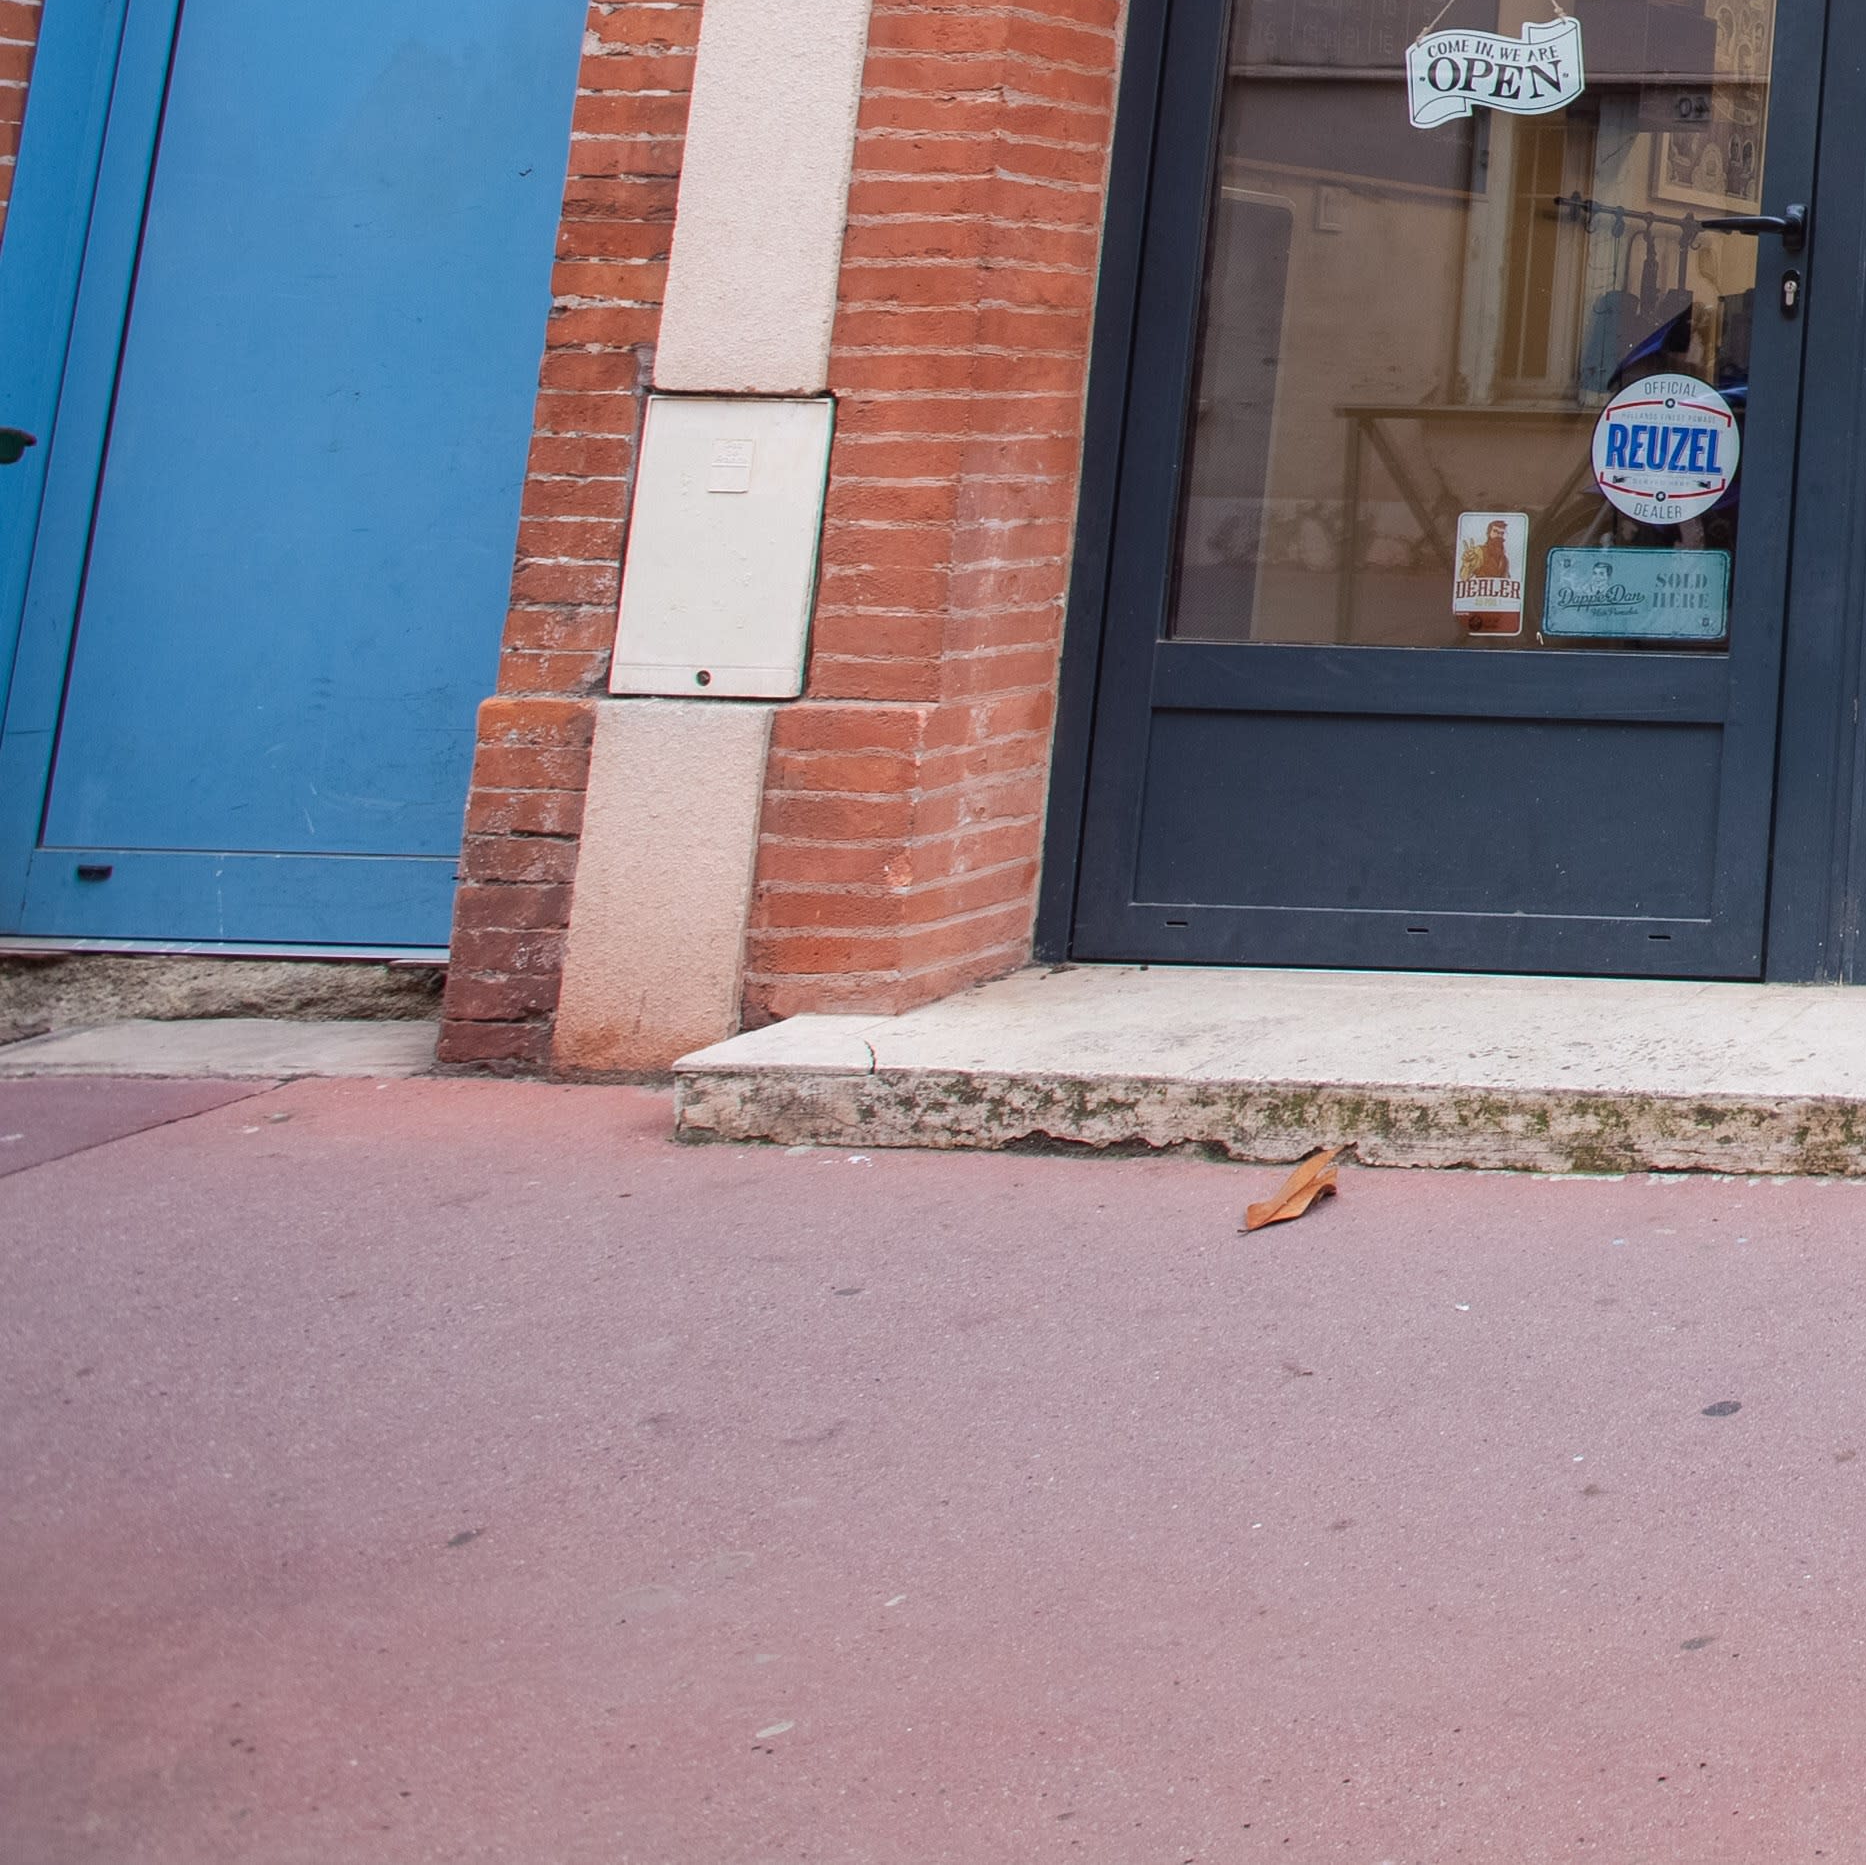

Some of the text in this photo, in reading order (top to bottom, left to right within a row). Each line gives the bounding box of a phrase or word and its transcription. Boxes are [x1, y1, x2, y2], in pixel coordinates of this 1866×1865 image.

[1427, 39, 1560, 63] COME IN, WE ARE
[1427, 56, 1562, 100] OPEN
[1643, 381, 1697, 398] OFFICIAL
[1605, 423, 1723, 475] REUZEL
[1633, 502, 1682, 520] DEALER
[1455, 579, 1521, 600] DEALER
[1655, 573, 1708, 589] SOLD
[1605, 584, 1645, 606] Dan
[1652, 592, 1710, 609] HERE
